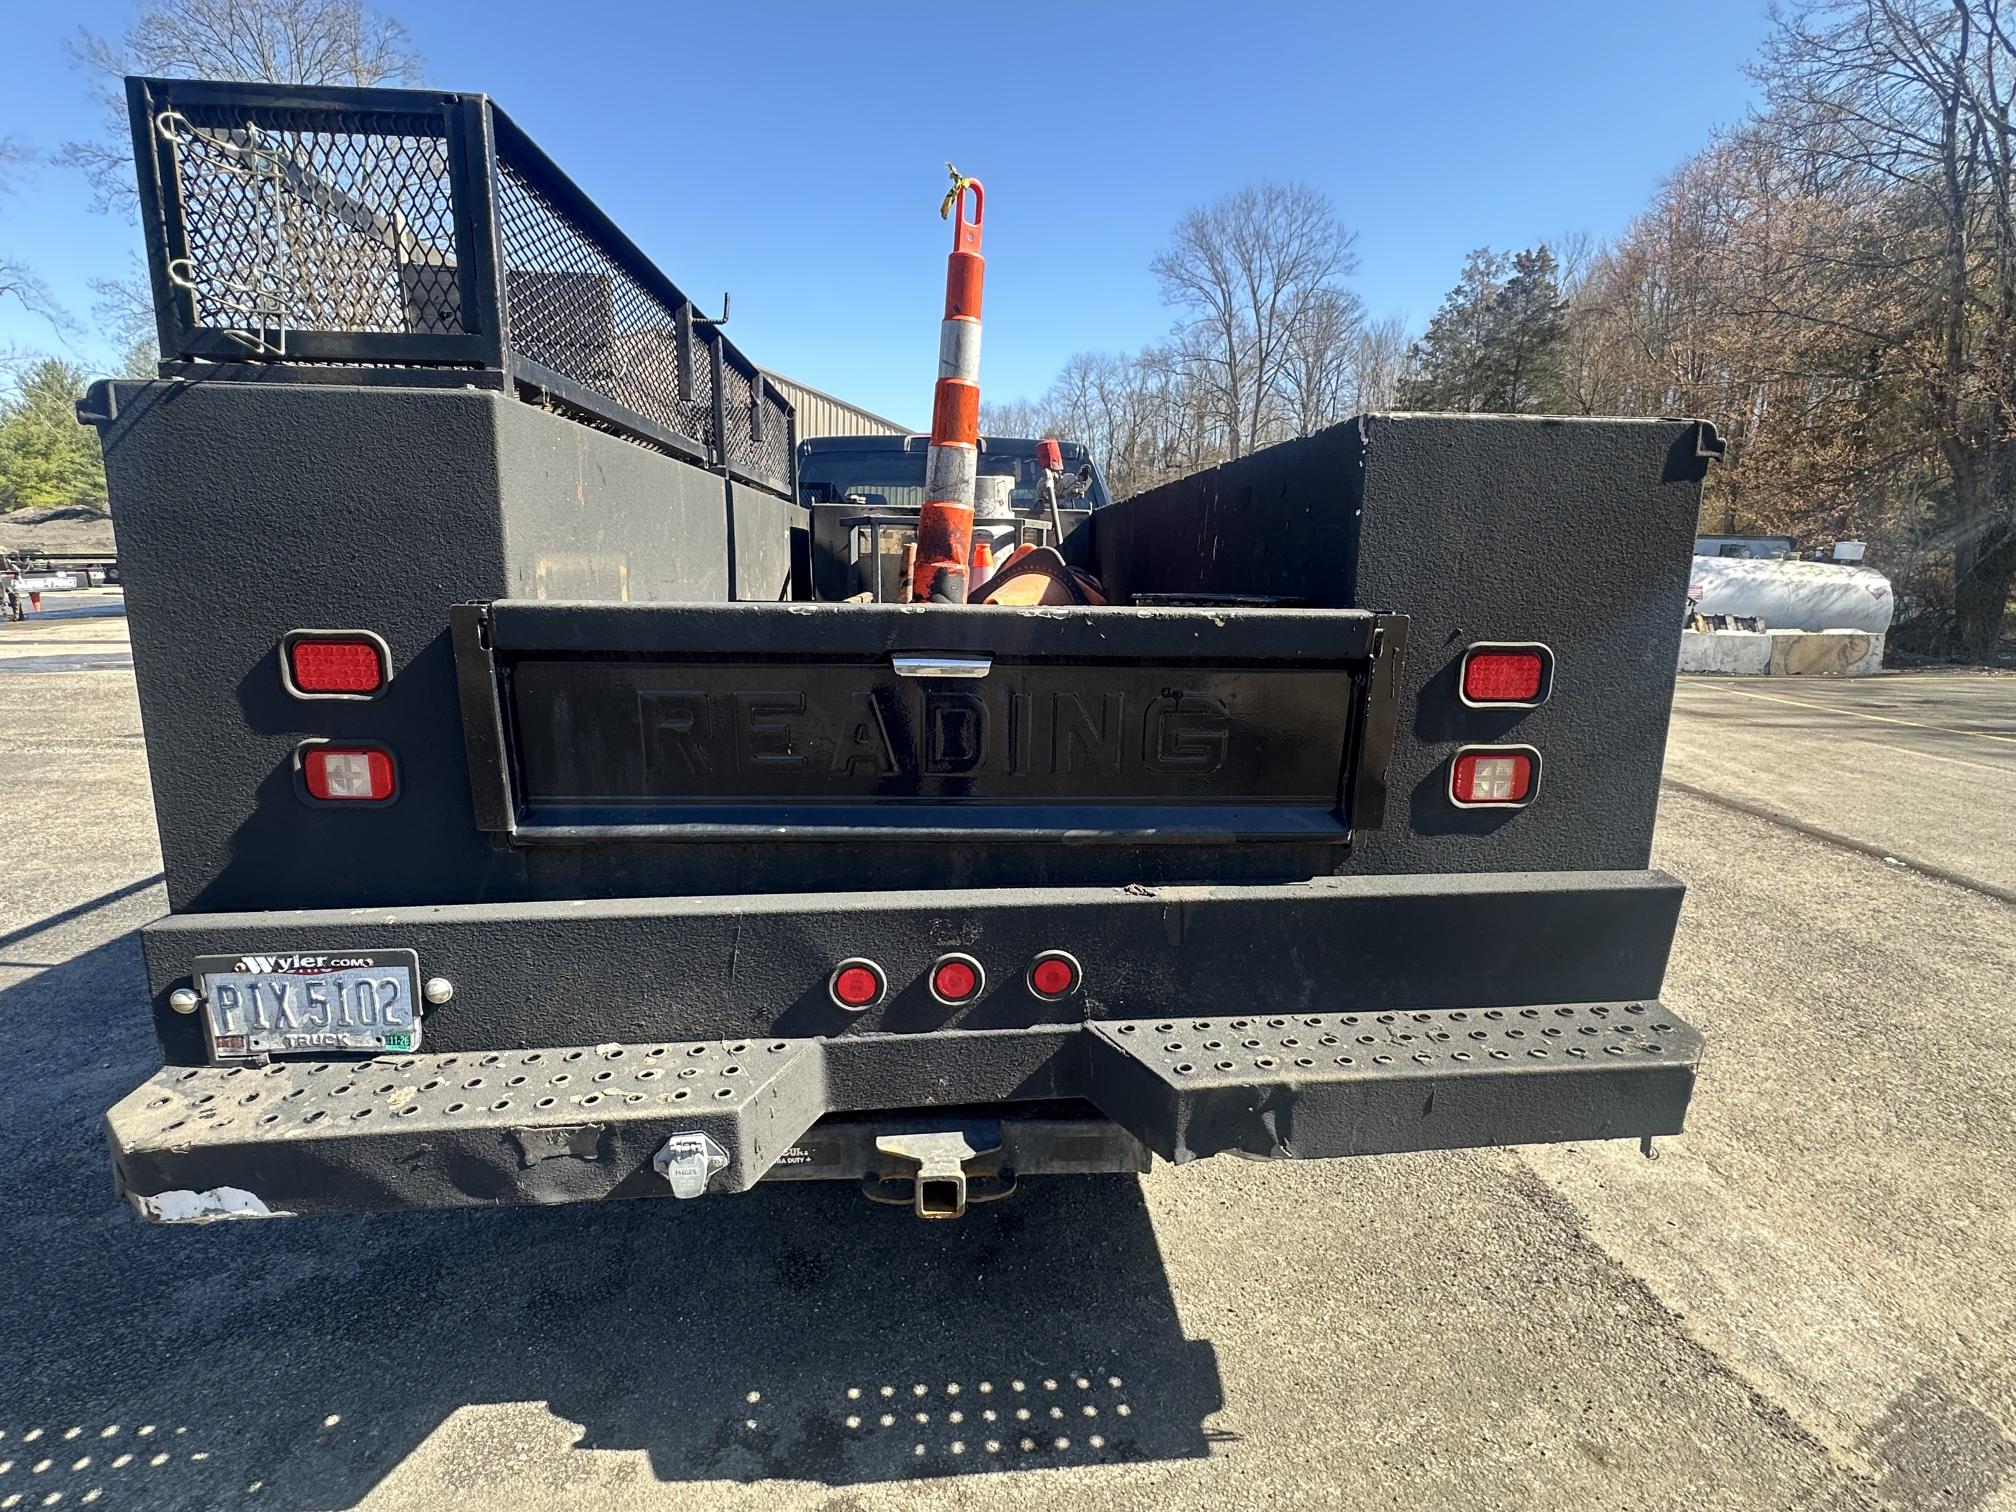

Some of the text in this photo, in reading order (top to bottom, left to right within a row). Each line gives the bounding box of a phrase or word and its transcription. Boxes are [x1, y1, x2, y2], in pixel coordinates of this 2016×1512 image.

[638, 689, 1230, 776] READING
[304, 977, 402, 1027] 5102
[284, 1033, 351, 1048] TRUCK
